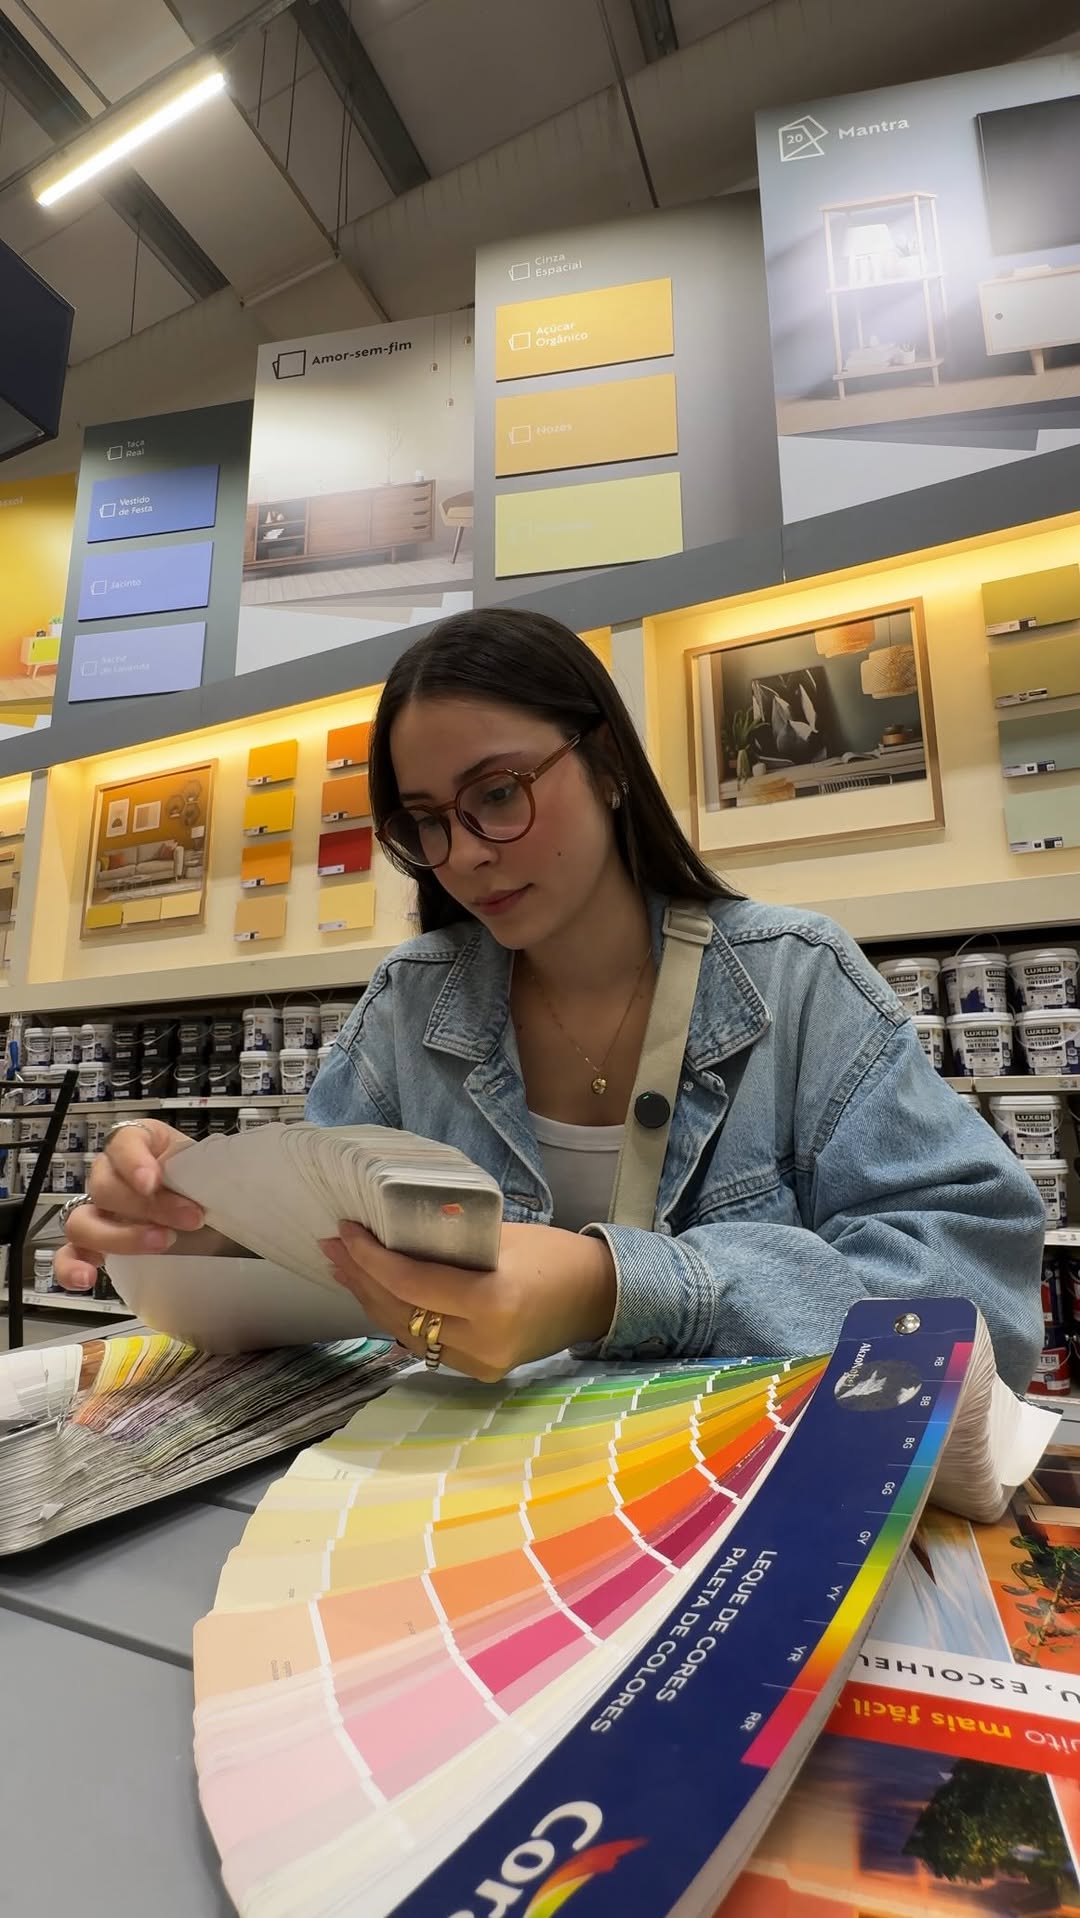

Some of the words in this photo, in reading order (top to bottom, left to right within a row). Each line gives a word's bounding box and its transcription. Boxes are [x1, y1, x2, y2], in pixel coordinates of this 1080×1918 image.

[786, 133, 803, 145] 20
[838, 119, 910, 139] Mantra
[535, 254, 566, 266] Cinza
[535, 260, 583, 278] Espacial
[536, 322, 576, 336] Açúcar
[535, 331, 589, 348] Orgânico
[312, 341, 412, 366] Amor-sem-fim
[126, 439, 145, 449] Taça
[126, 449, 145, 458] Real
[119, 495, 151, 506] Vestido
[118, 507, 130, 516] de
[131, 504, 153, 515] Festa
[109, 578, 142, 590] Jacinto
[1027, 967, 1060, 976] LUXENS
[1026, 1029, 1060, 1037] LUXENS
[934, 1356, 945, 1367] RB
[920, 1395, 931, 1406] BB
[903, 1437, 915, 1449] BG
[882, 1481, 895, 1495] GG
[857, 1530, 871, 1545] GY
[691, 1547, 747, 1608] PALETA
[728, 1550, 777, 1605] LEQUE
[826, 1584, 844, 1602] YY
[669, 1612, 699, 1638] DE
[708, 1607, 739, 1634] DE
[787, 1645, 808, 1663] YR
[655, 1636, 717, 1702] CORES
[590, 1640, 677, 1733] COLORES
[853, 1697, 921, 1724] fácil
[740, 1711, 762, 1733] RR
[931, 1711, 1012, 1739] mais
[447, 1801, 603, 1918] Cor
